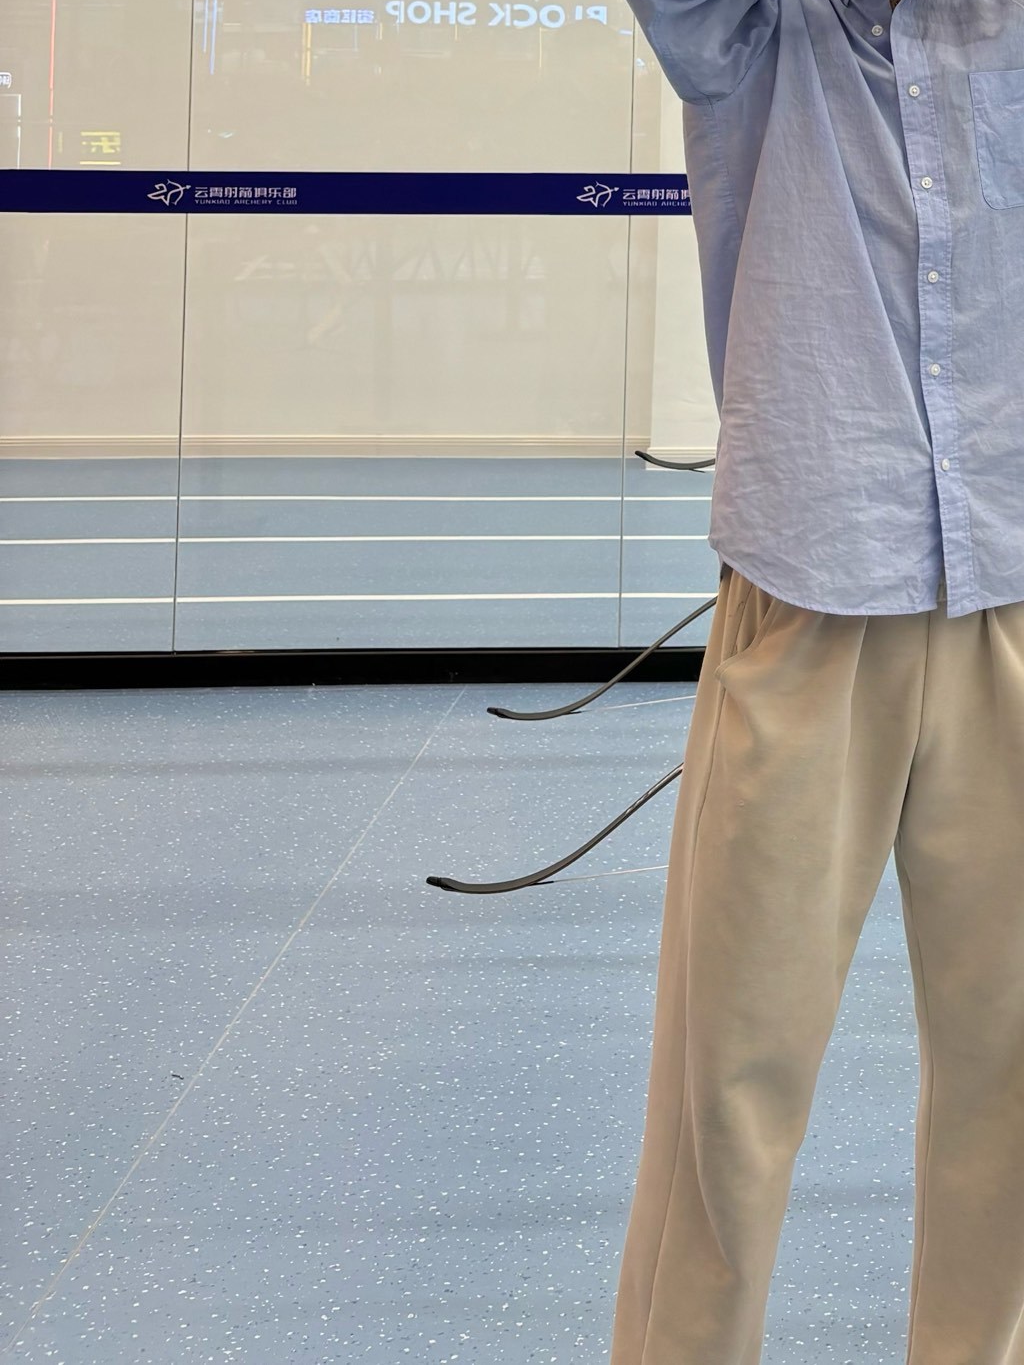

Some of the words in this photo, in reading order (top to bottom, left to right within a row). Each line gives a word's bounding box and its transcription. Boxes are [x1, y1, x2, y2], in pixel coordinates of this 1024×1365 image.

[194, 187, 297, 198] 云霄射箭俱乐部
